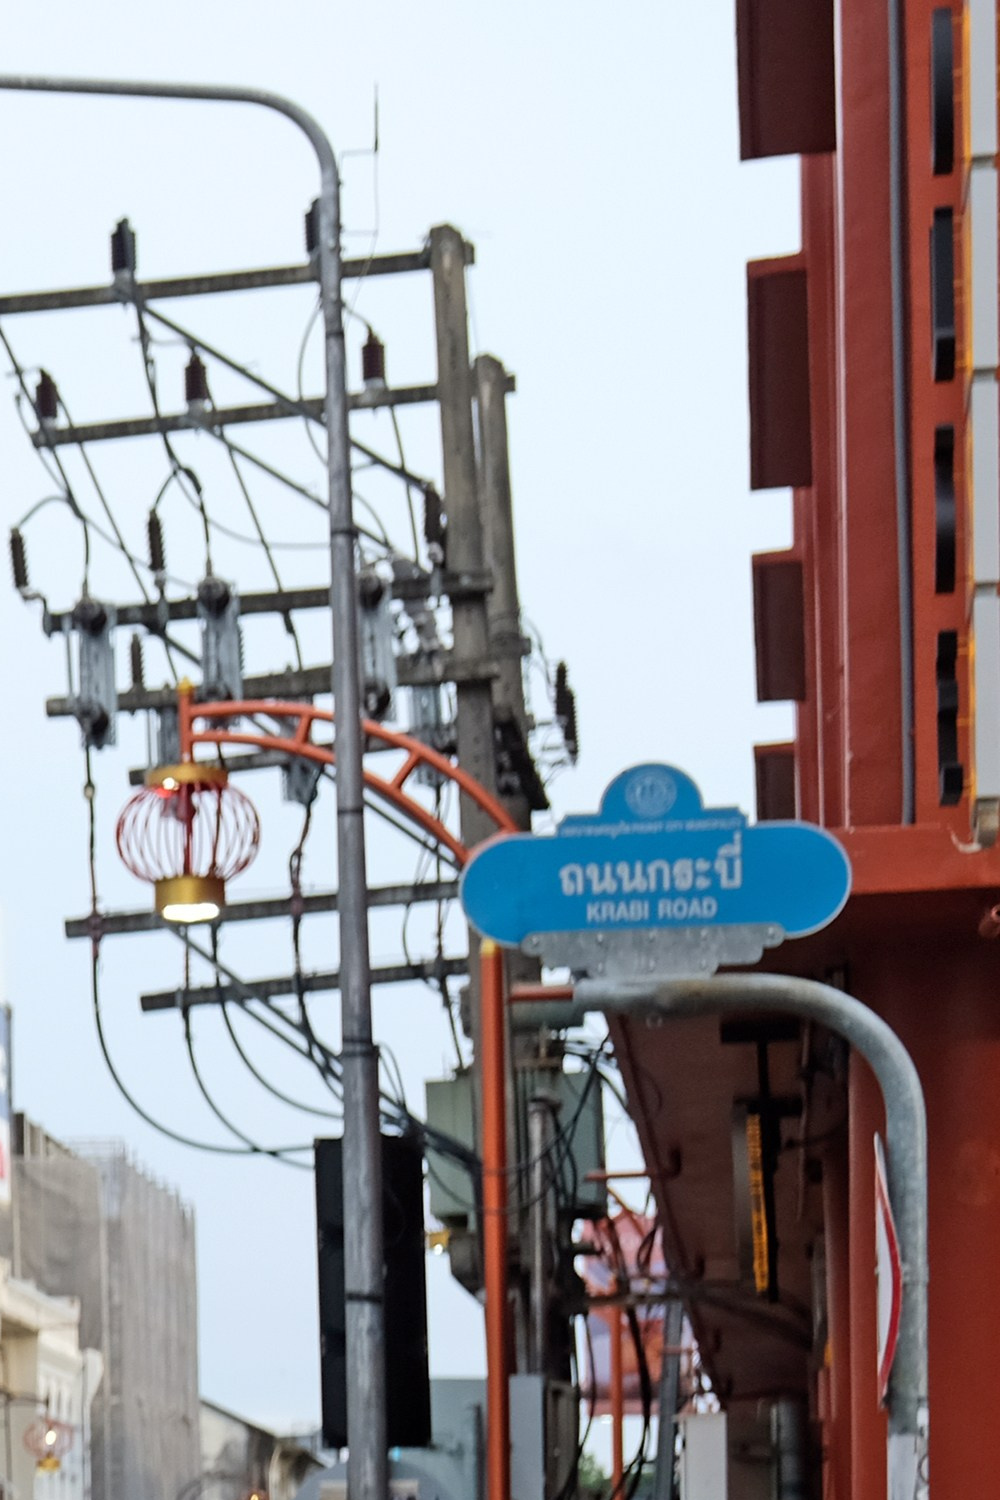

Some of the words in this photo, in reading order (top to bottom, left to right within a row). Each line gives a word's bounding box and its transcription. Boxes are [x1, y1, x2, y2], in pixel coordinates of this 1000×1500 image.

[558, 831, 744, 896] ถนนกระบี่
[586, 899, 650, 924] KRABI
[658, 896, 718, 921] ROAD
